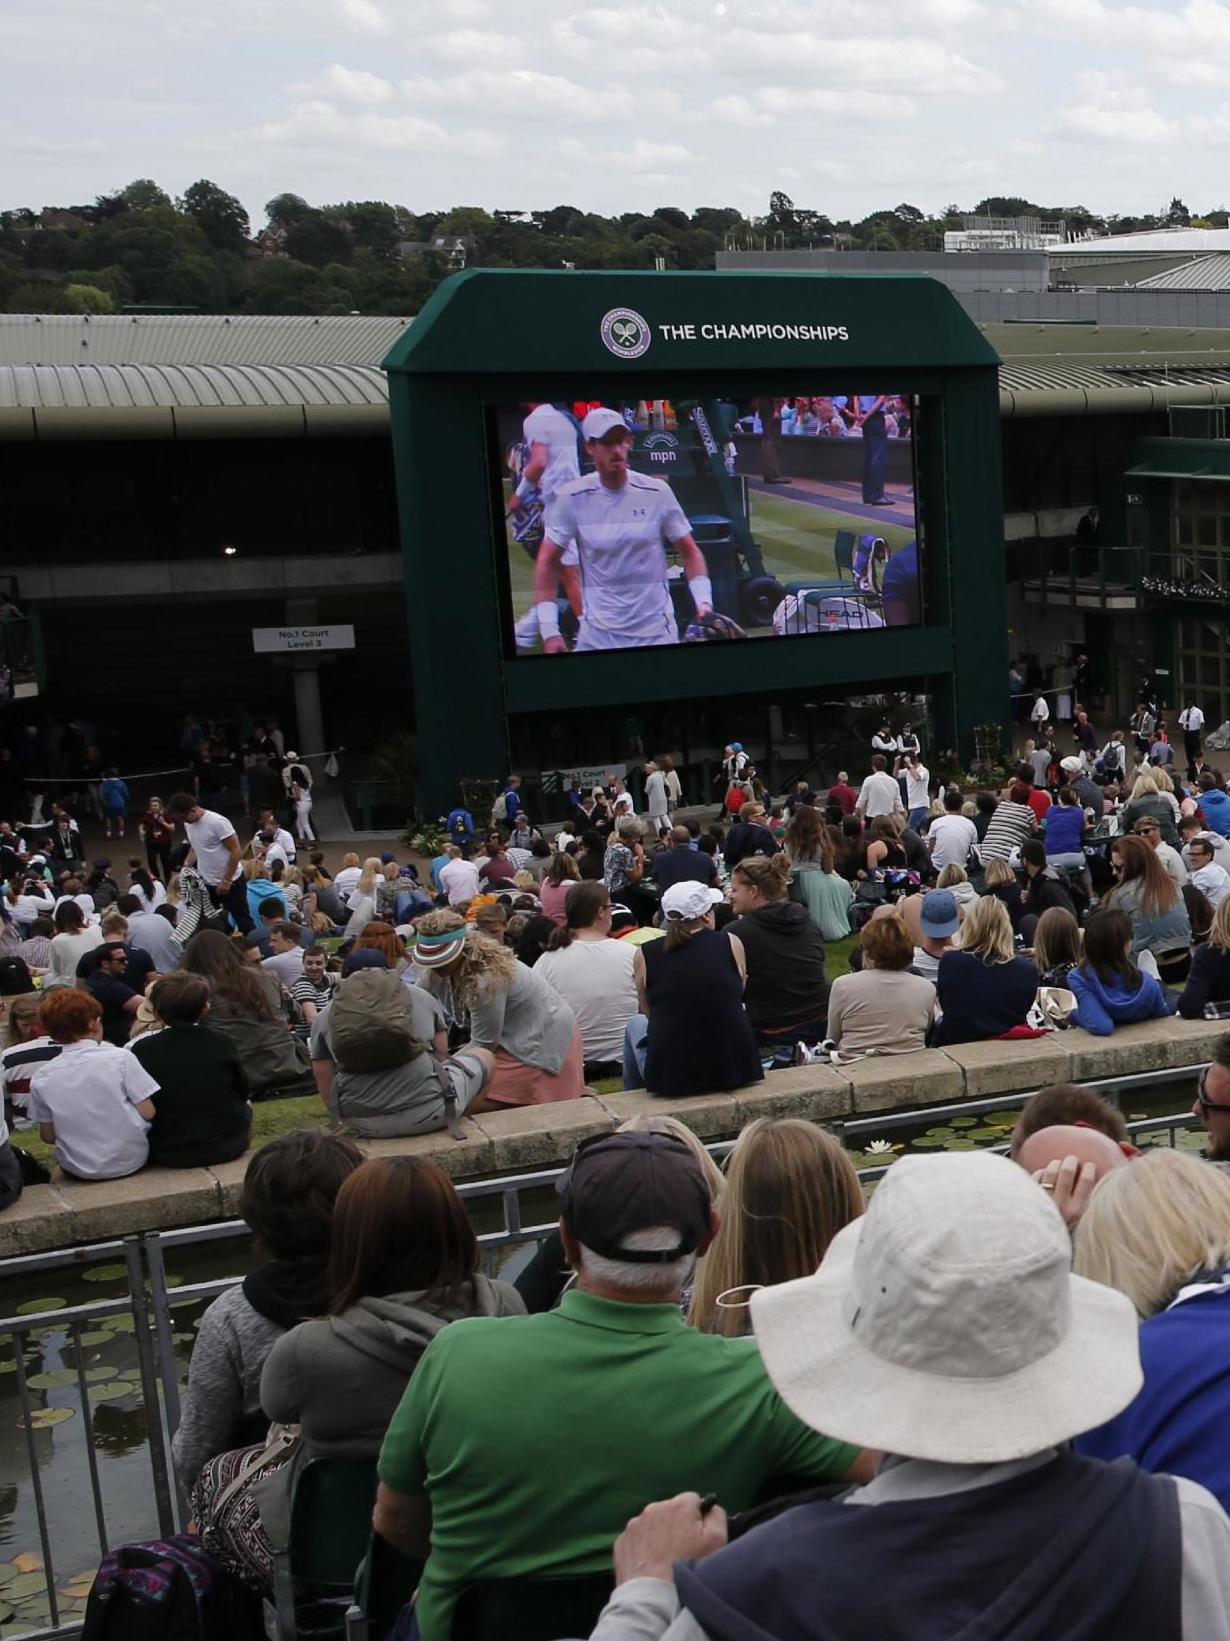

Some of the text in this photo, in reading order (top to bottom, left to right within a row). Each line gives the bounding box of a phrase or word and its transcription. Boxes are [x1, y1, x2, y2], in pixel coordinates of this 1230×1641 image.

[659, 325, 849, 341] THE CHAMPIONSHIPS
[279, 630, 329, 640] No.1 Court
[287, 640, 314, 649] Level
[583, 770, 606, 779] Court
